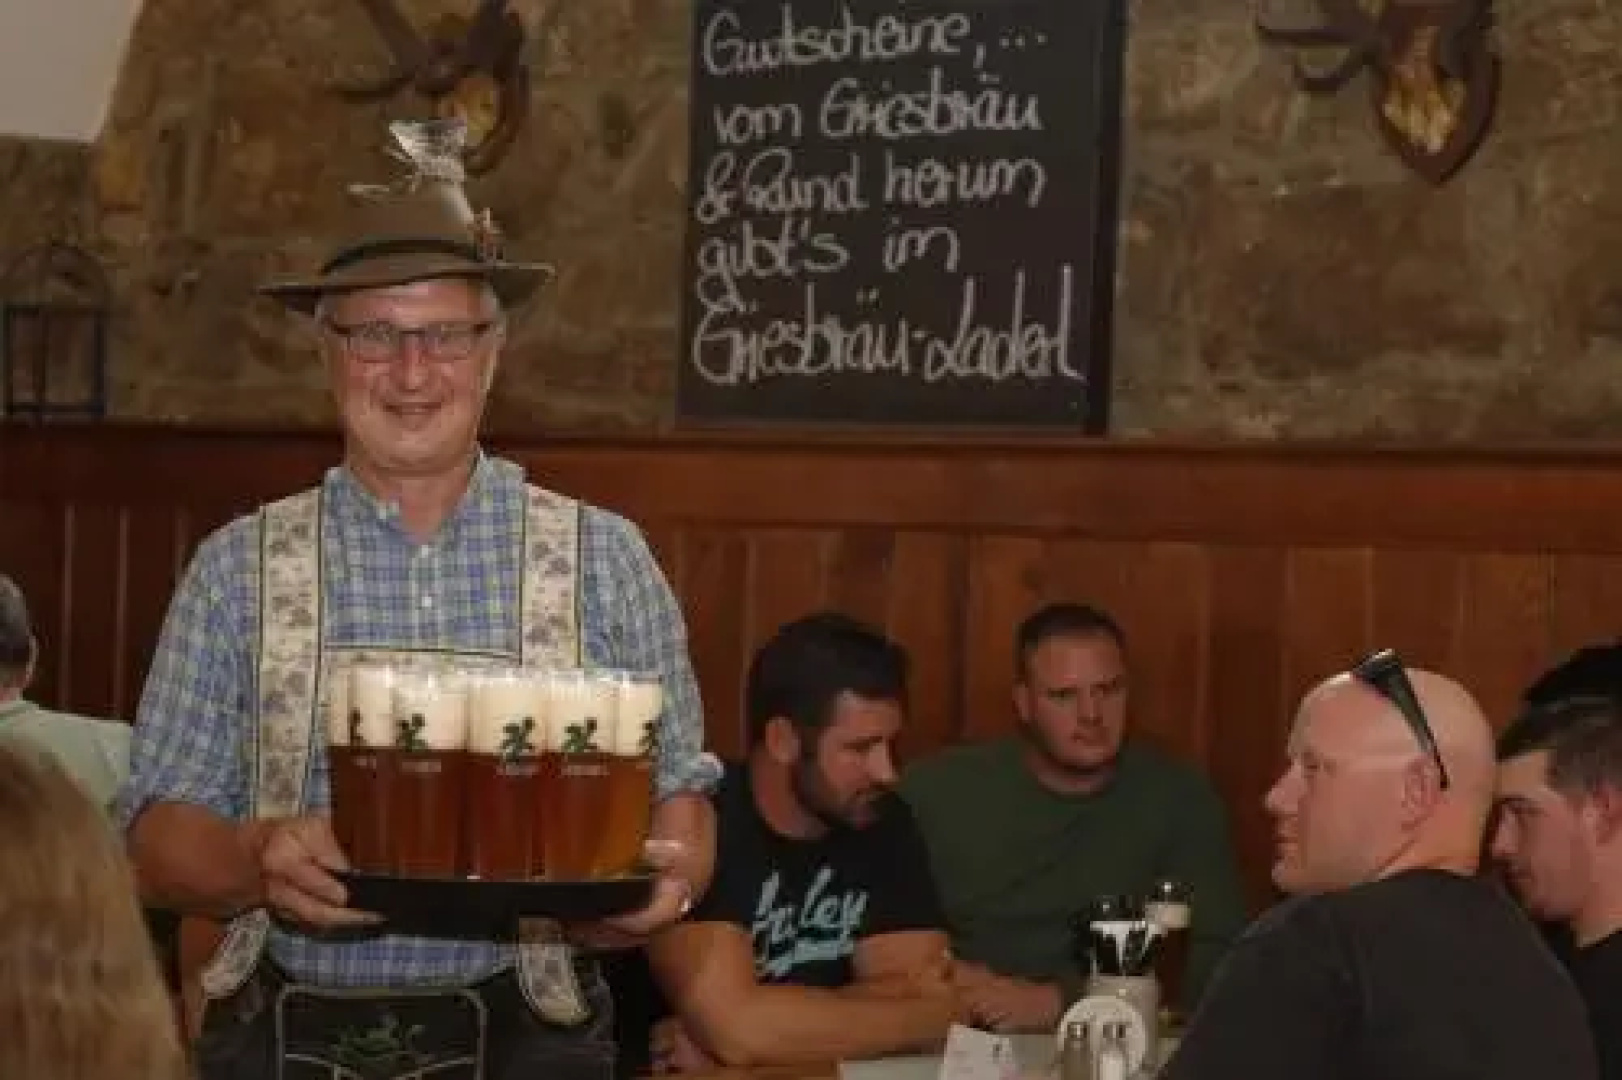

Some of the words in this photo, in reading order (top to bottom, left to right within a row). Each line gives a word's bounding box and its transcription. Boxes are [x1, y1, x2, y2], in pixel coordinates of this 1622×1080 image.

[714, 103, 802, 144] vom
[884, 149, 1047, 208] herum
[884, 214, 960, 272] im
